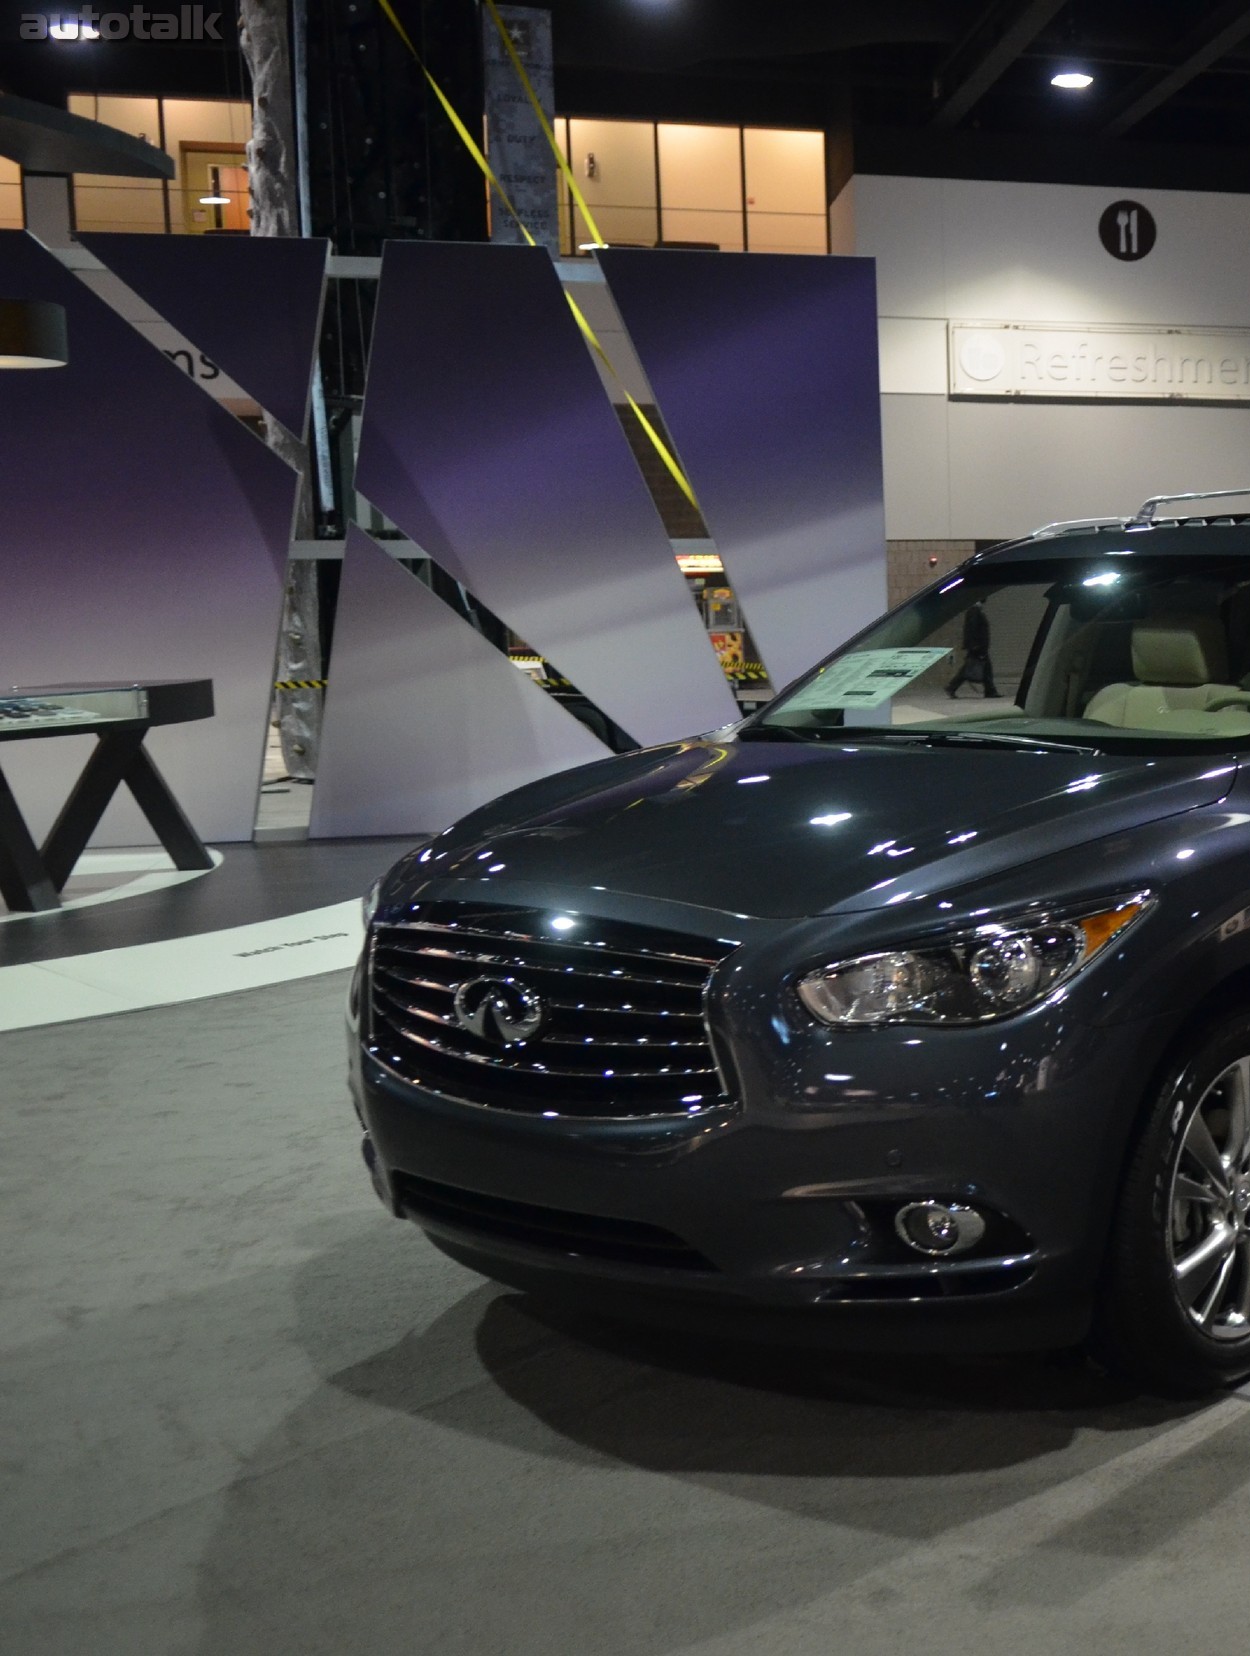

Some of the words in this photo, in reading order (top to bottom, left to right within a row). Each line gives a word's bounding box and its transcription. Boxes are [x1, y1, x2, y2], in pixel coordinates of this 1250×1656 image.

[497, 93, 542, 105] LOYALY
[507, 134, 537, 144] DUTY
[499, 173, 547, 184] RESPECT
[498, 207, 550, 218] SEFLESS
